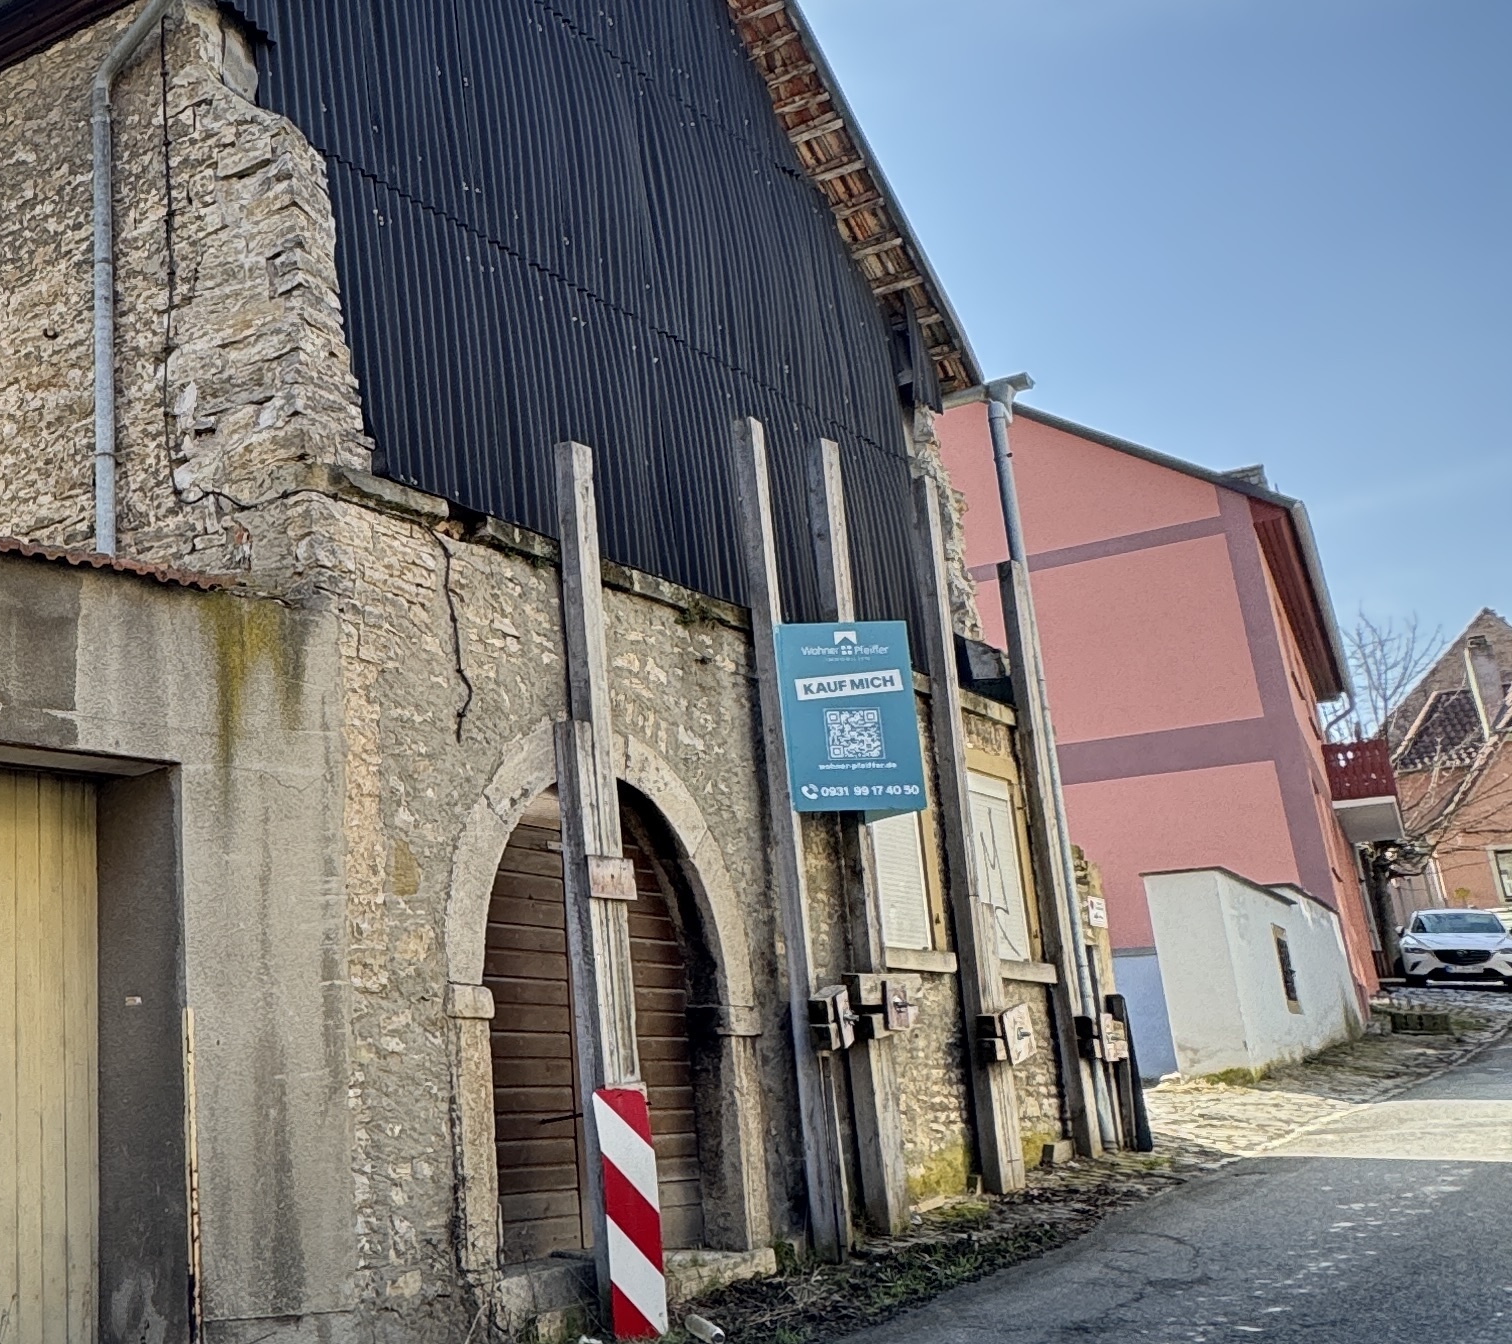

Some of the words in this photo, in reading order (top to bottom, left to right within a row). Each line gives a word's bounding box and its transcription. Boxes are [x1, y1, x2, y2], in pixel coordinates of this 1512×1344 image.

[801, 646, 839, 655] Wohner
[854, 645, 889, 655] Pfeiffer
[803, 680, 848, 695] KAUF
[850, 676, 895, 690] MICH
[818, 762, 897, 770] wohner-pfeiffer.de
[821, 786, 849, 796] 0931
[854, 786, 869, 796] 99
[871, 785, 883, 795] 17
[885, 785, 901, 795] 40
[904, 784, 919, 795] 50
